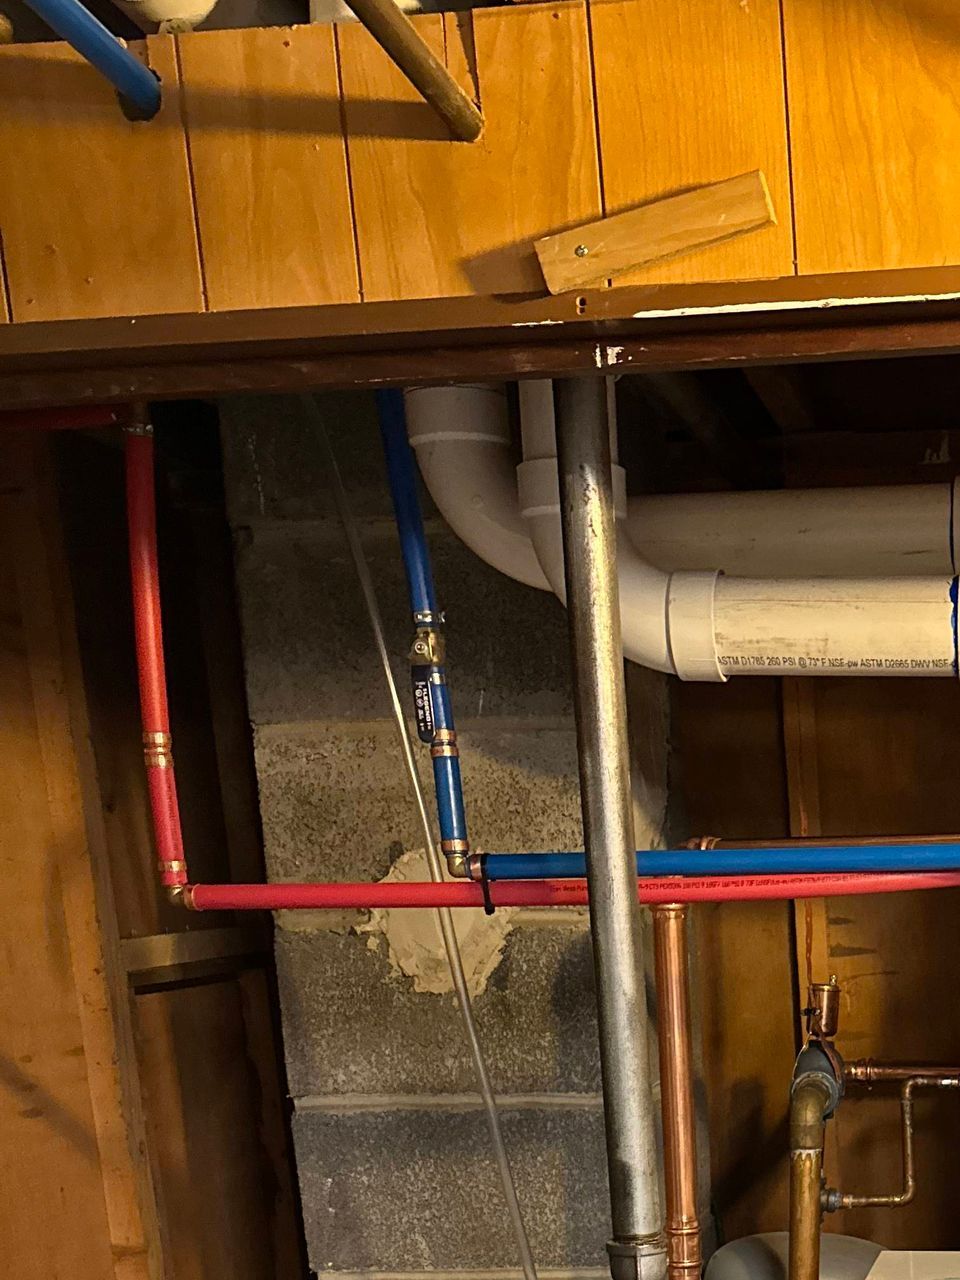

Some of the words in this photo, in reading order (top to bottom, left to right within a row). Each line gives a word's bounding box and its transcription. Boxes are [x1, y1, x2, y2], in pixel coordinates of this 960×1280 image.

[741, 655, 765, 666] D1785
[767, 656, 781, 666] 260
[783, 656, 797, 667] PSI
[798, 657, 807, 668] @
[860, 658, 883, 668] ASTM
[885, 659, 909, 669] D2665
[911, 659, 931, 669] DWV
